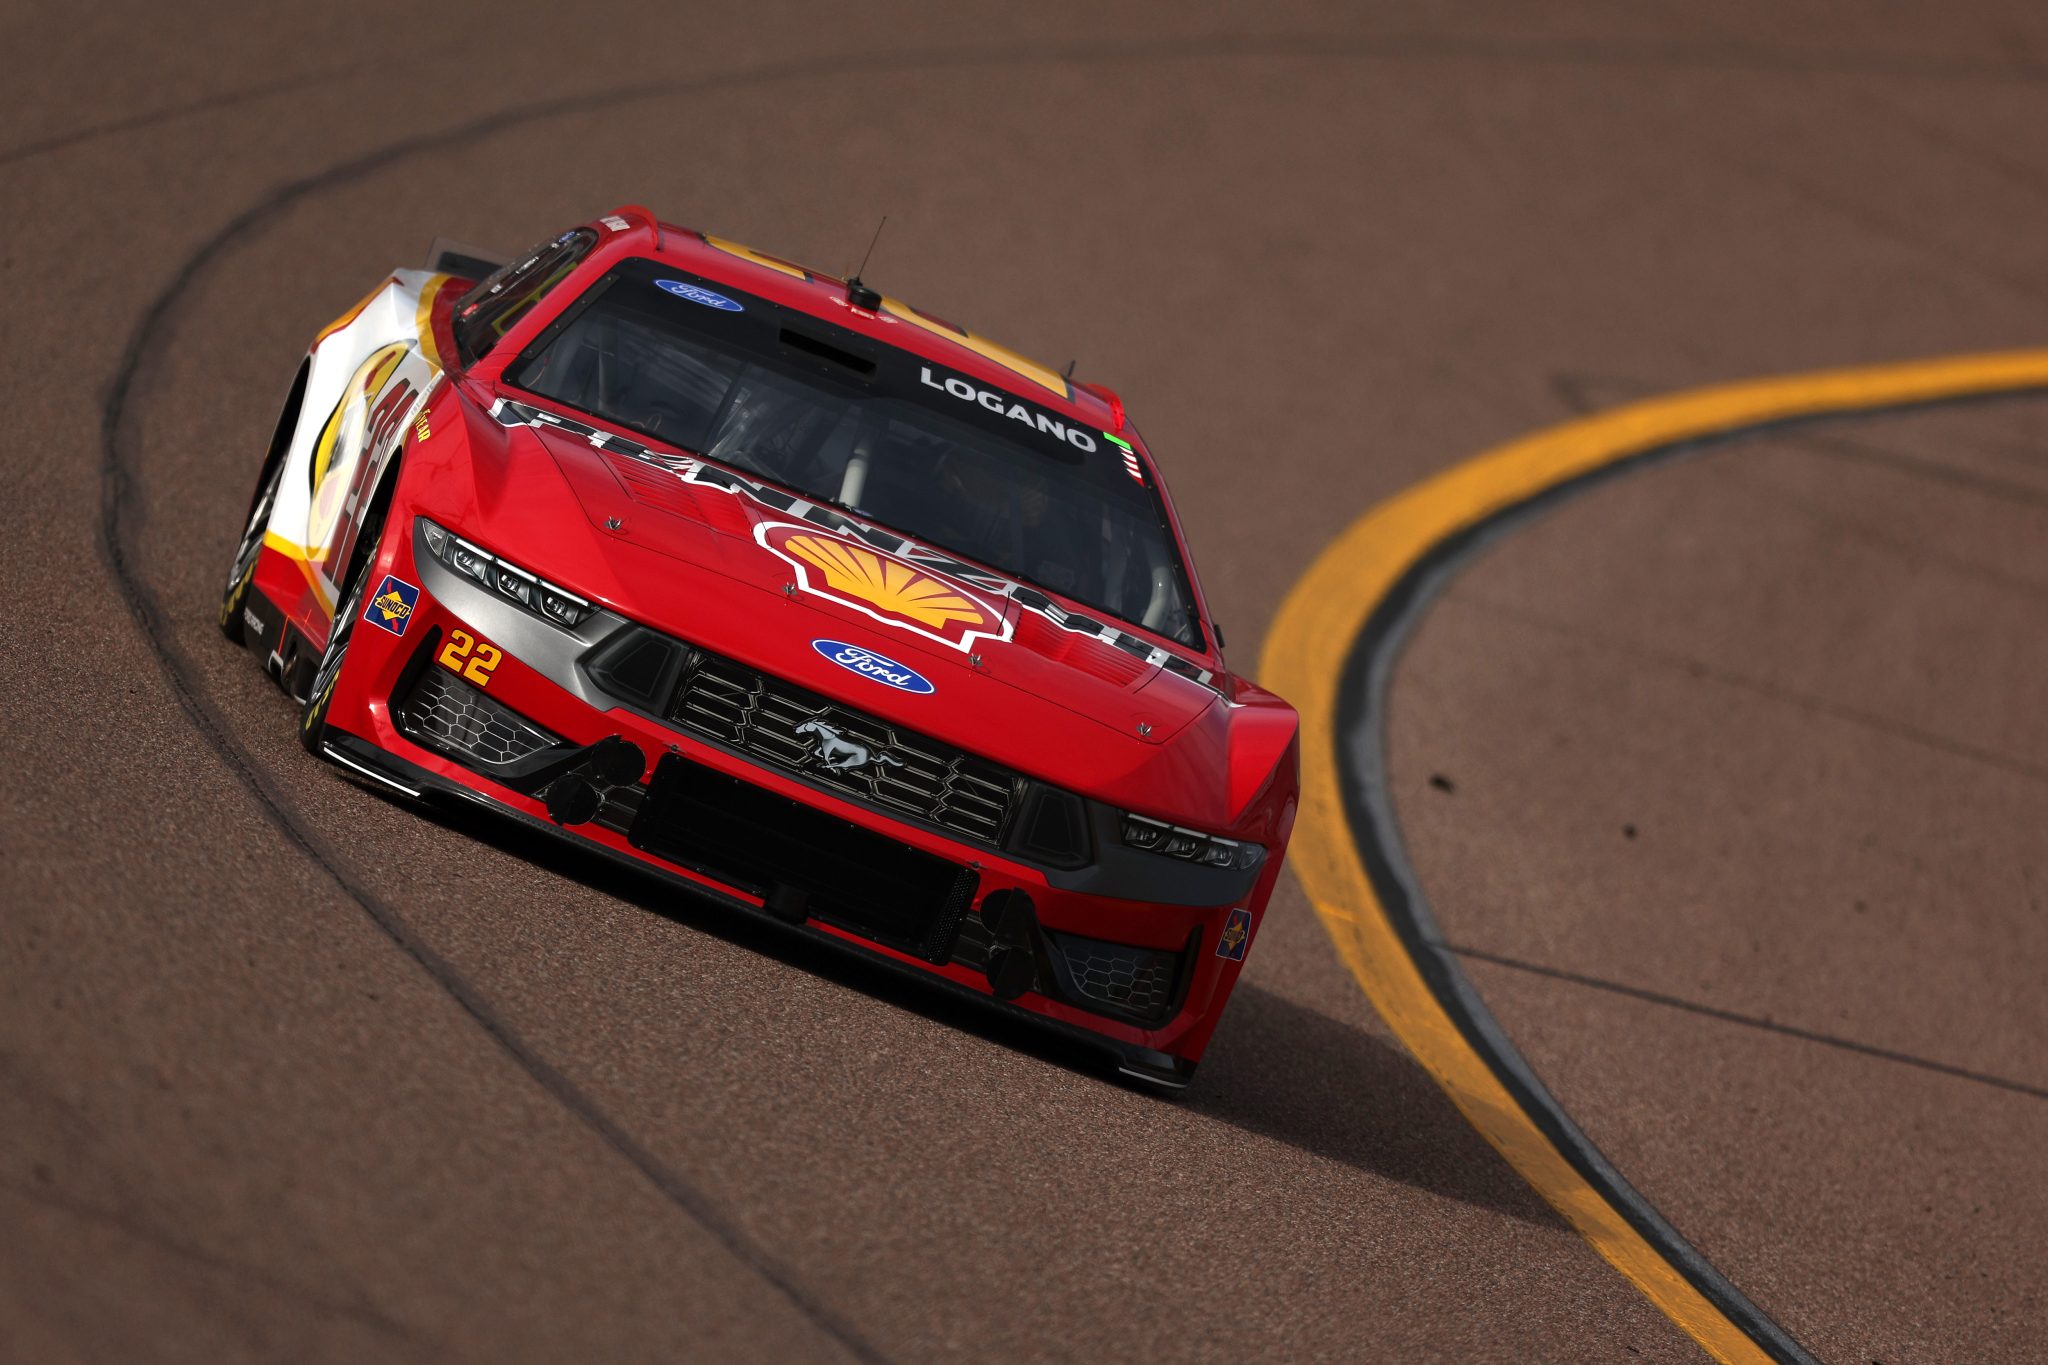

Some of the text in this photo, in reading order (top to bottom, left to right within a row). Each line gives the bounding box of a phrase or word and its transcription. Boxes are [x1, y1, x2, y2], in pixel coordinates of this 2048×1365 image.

[671, 284, 727, 307] Ford
[920, 366, 1097, 453] LOGANO
[376, 595, 411, 618] SUNOCO
[438, 629, 503, 687] 22
[834, 647, 912, 686] Ford
